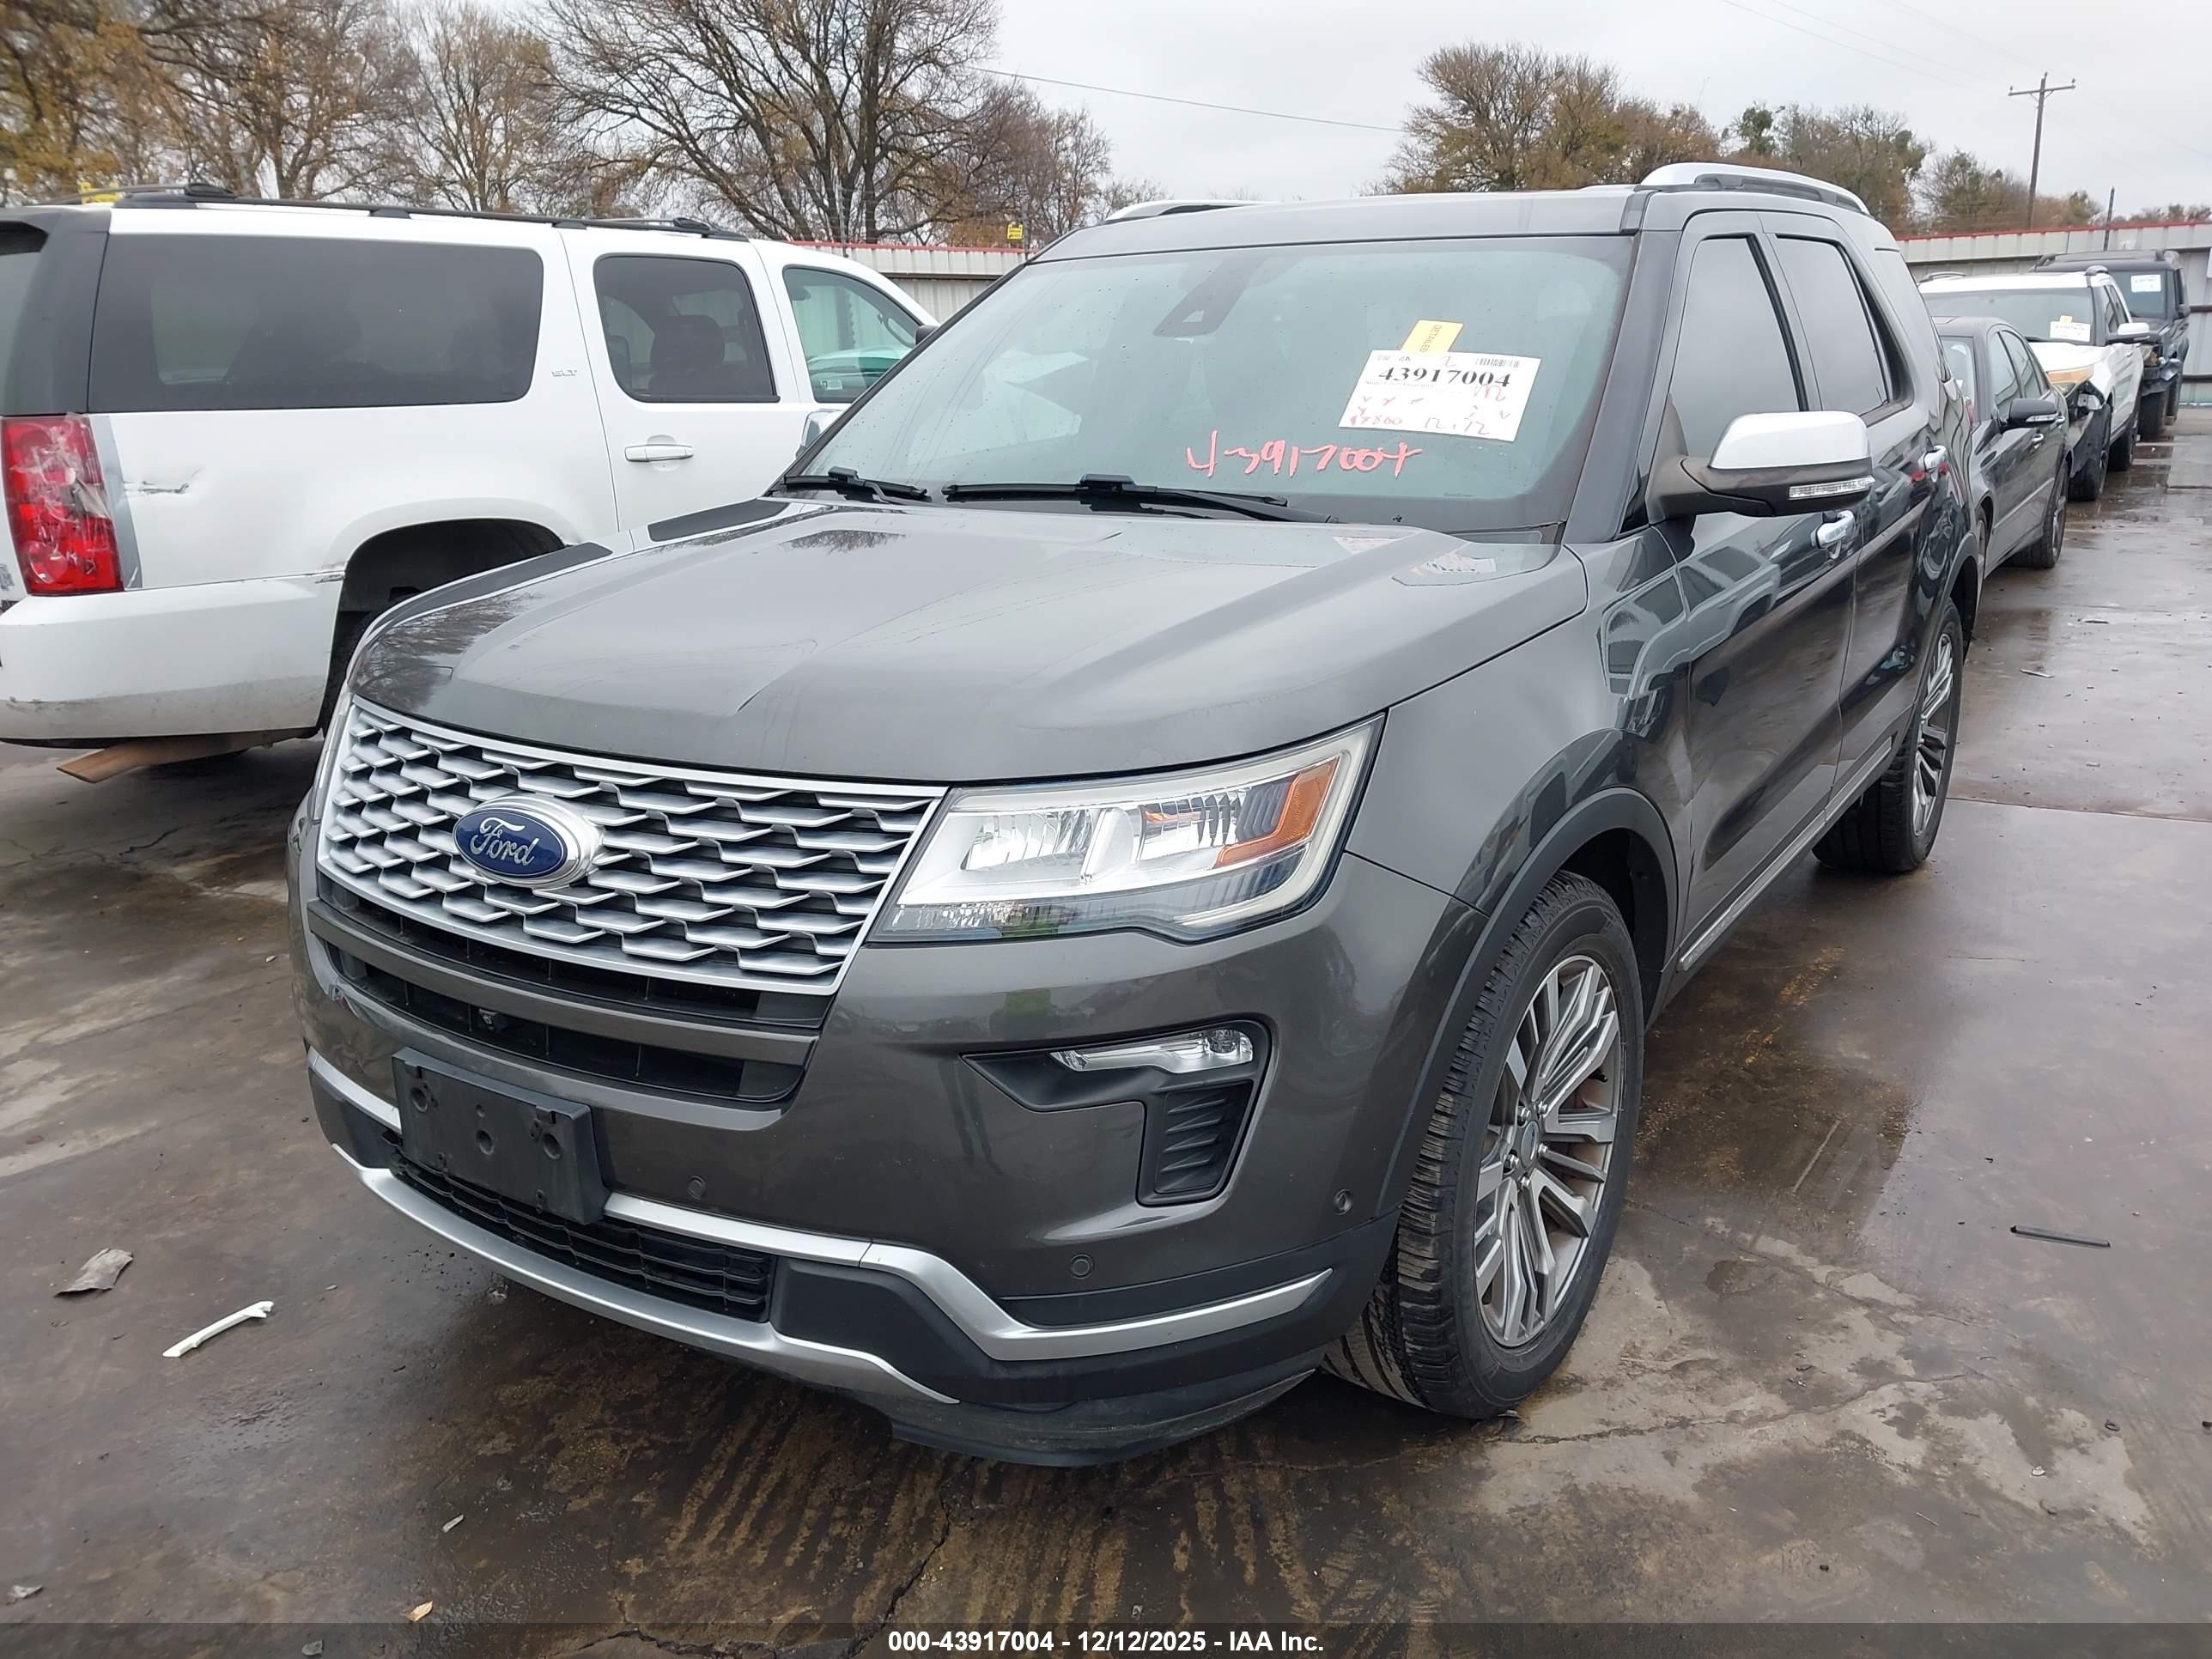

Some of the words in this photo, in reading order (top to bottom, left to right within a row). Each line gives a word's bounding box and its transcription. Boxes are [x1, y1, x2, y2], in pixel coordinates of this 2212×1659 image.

[1419, 325, 1443, 353] DETAILED
[1378, 367, 1512, 387] 43917004
[1186, 429, 1424, 478] 43917004
[470, 817, 540, 866] Ford
